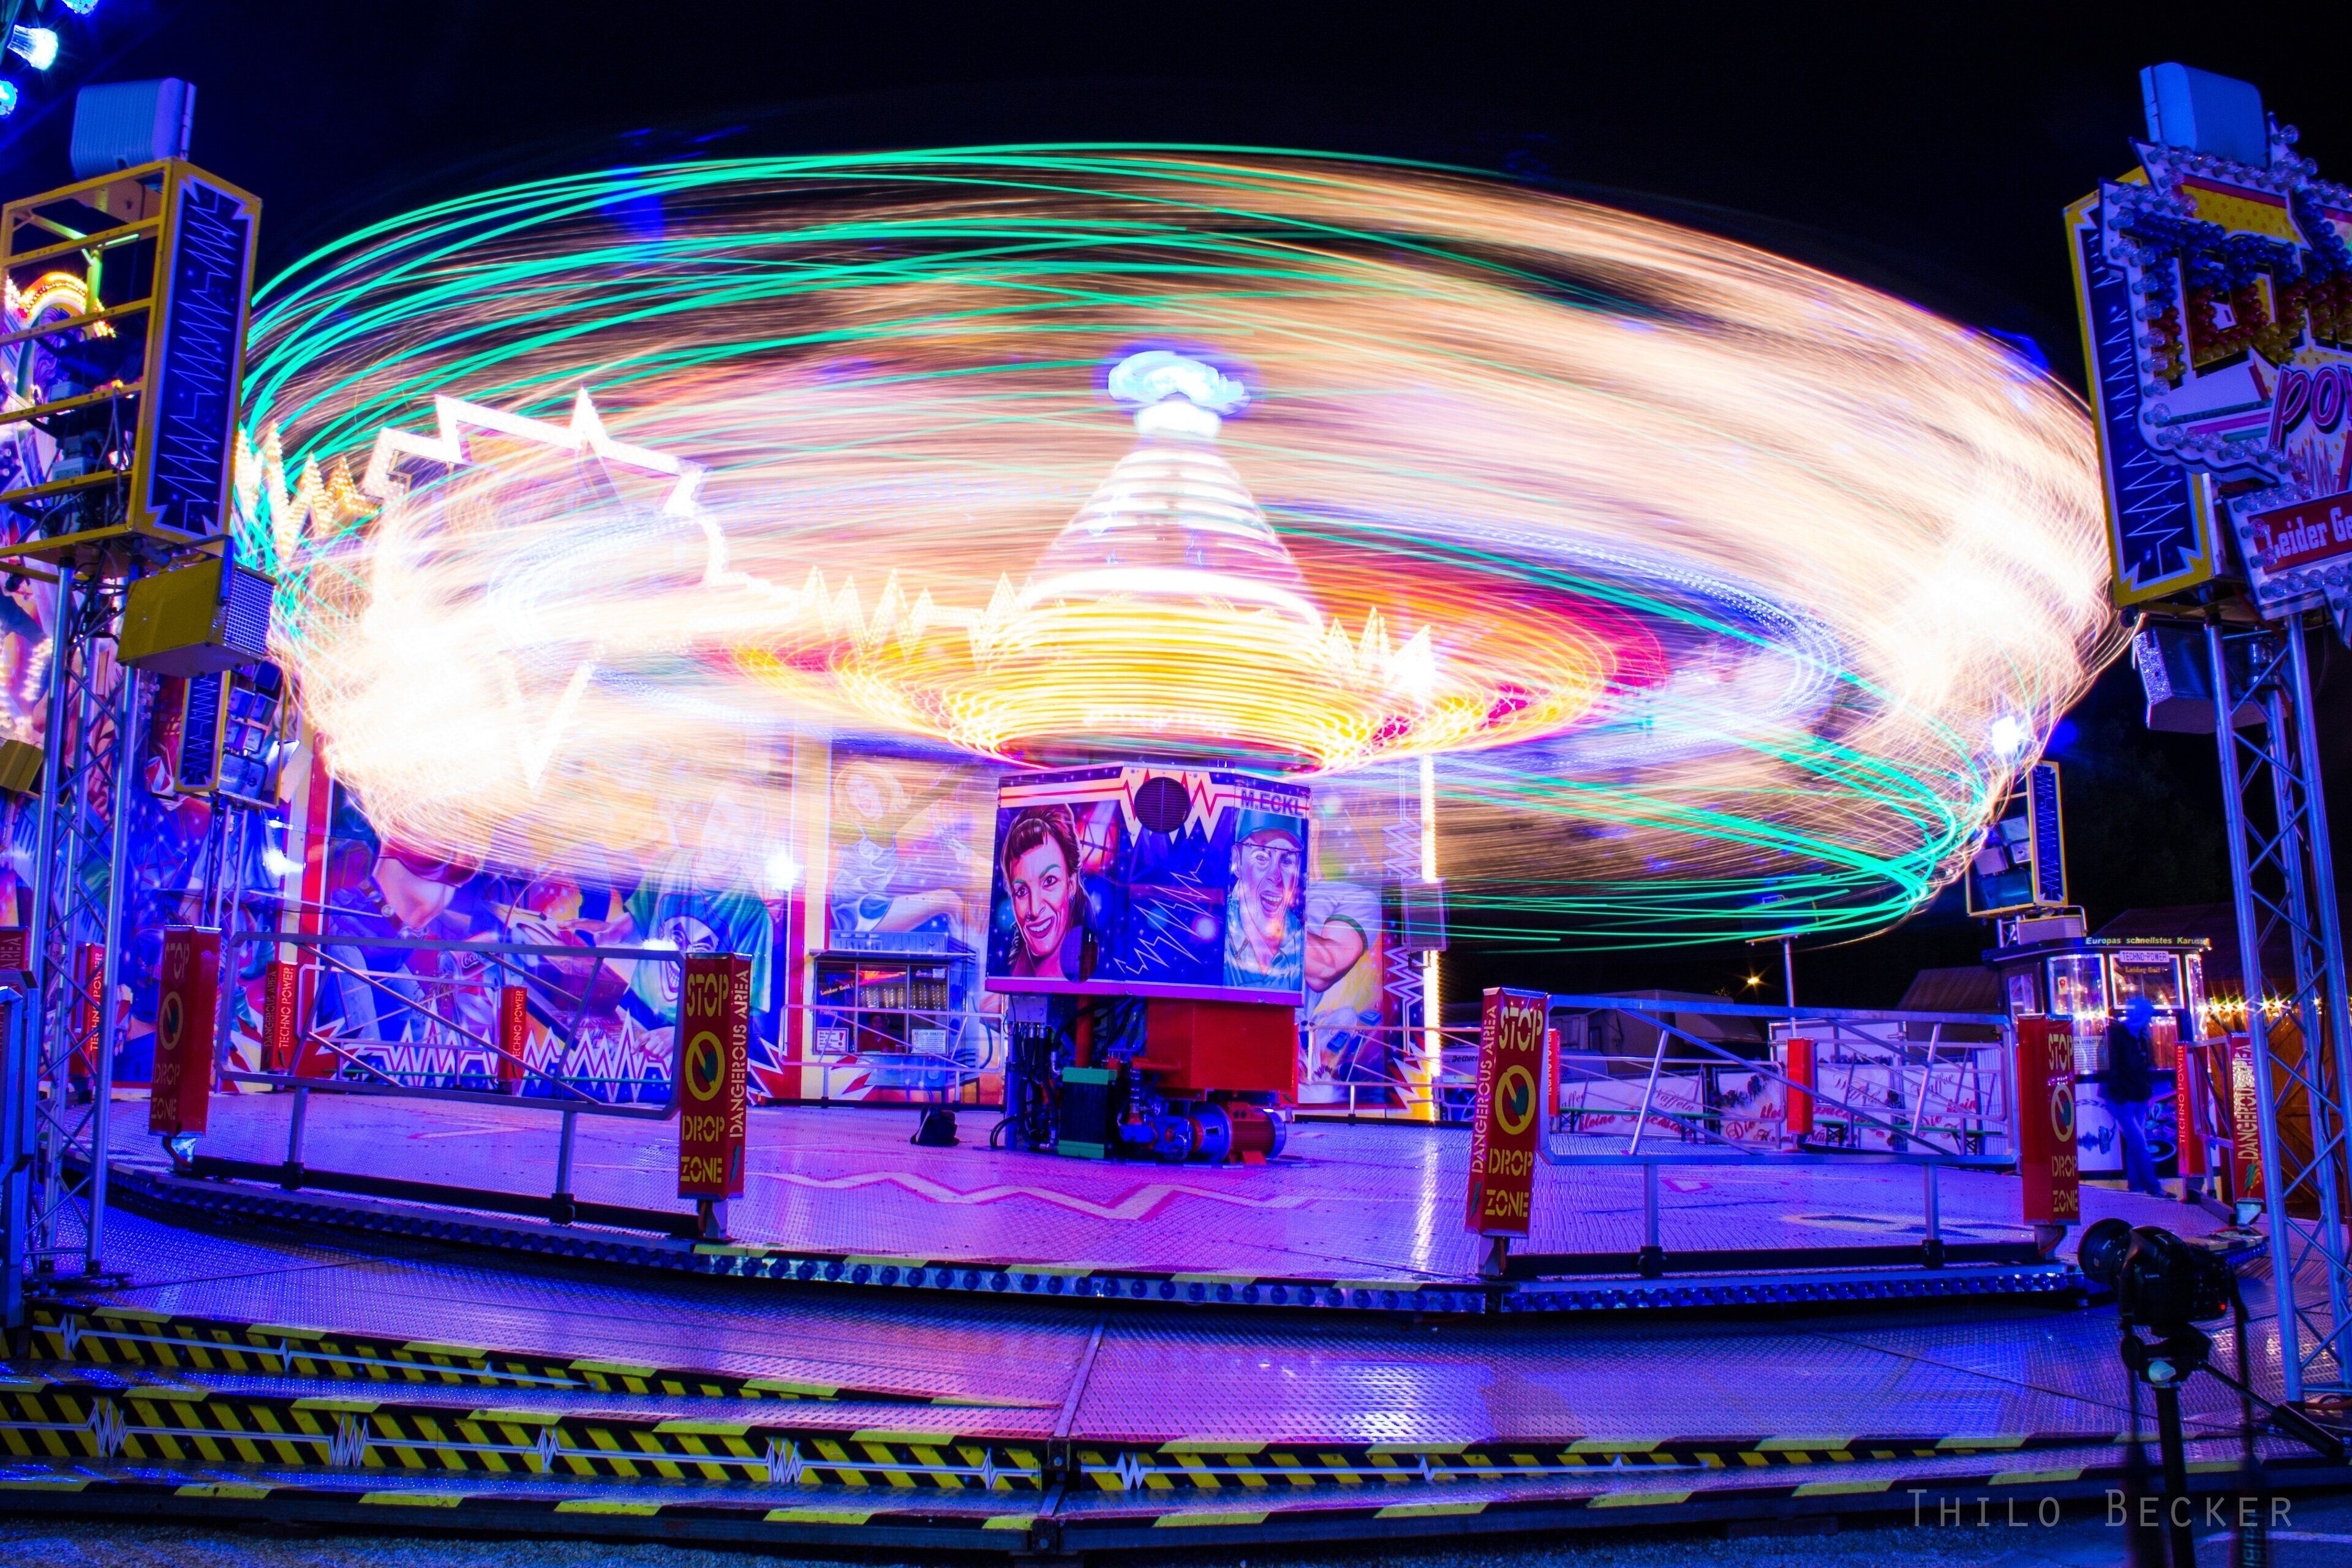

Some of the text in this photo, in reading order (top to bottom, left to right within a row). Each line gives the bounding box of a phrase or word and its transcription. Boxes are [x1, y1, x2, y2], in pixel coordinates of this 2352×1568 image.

[1240, 788, 1304, 817] M.ECKL
[2086, 937, 2121, 946] Europas
[279, 967, 293, 1048] TECHNO POWER
[687, 973, 729, 1017] STOP
[512, 990, 524, 1057] ECHNO POWER
[1498, 1006, 1544, 1052] STOP
[729, 970, 749, 1137] DANGEROUS AREA
[2048, 1033, 2074, 1072] STOP
[155, 1063, 180, 1085] DROP
[1471, 1005, 1498, 1174] DANGEROUS AREA
[151, 1097, 178, 1120] ZONE
[682, 1115, 725, 1142] DROP
[680, 1156, 723, 1183] ZONE
[1488, 1148, 1534, 1177] DROP
[2051, 1155, 2078, 1177] DROP
[1485, 1189, 1529, 1218] ZONE
[2052, 1189, 2078, 1213] ZONE
